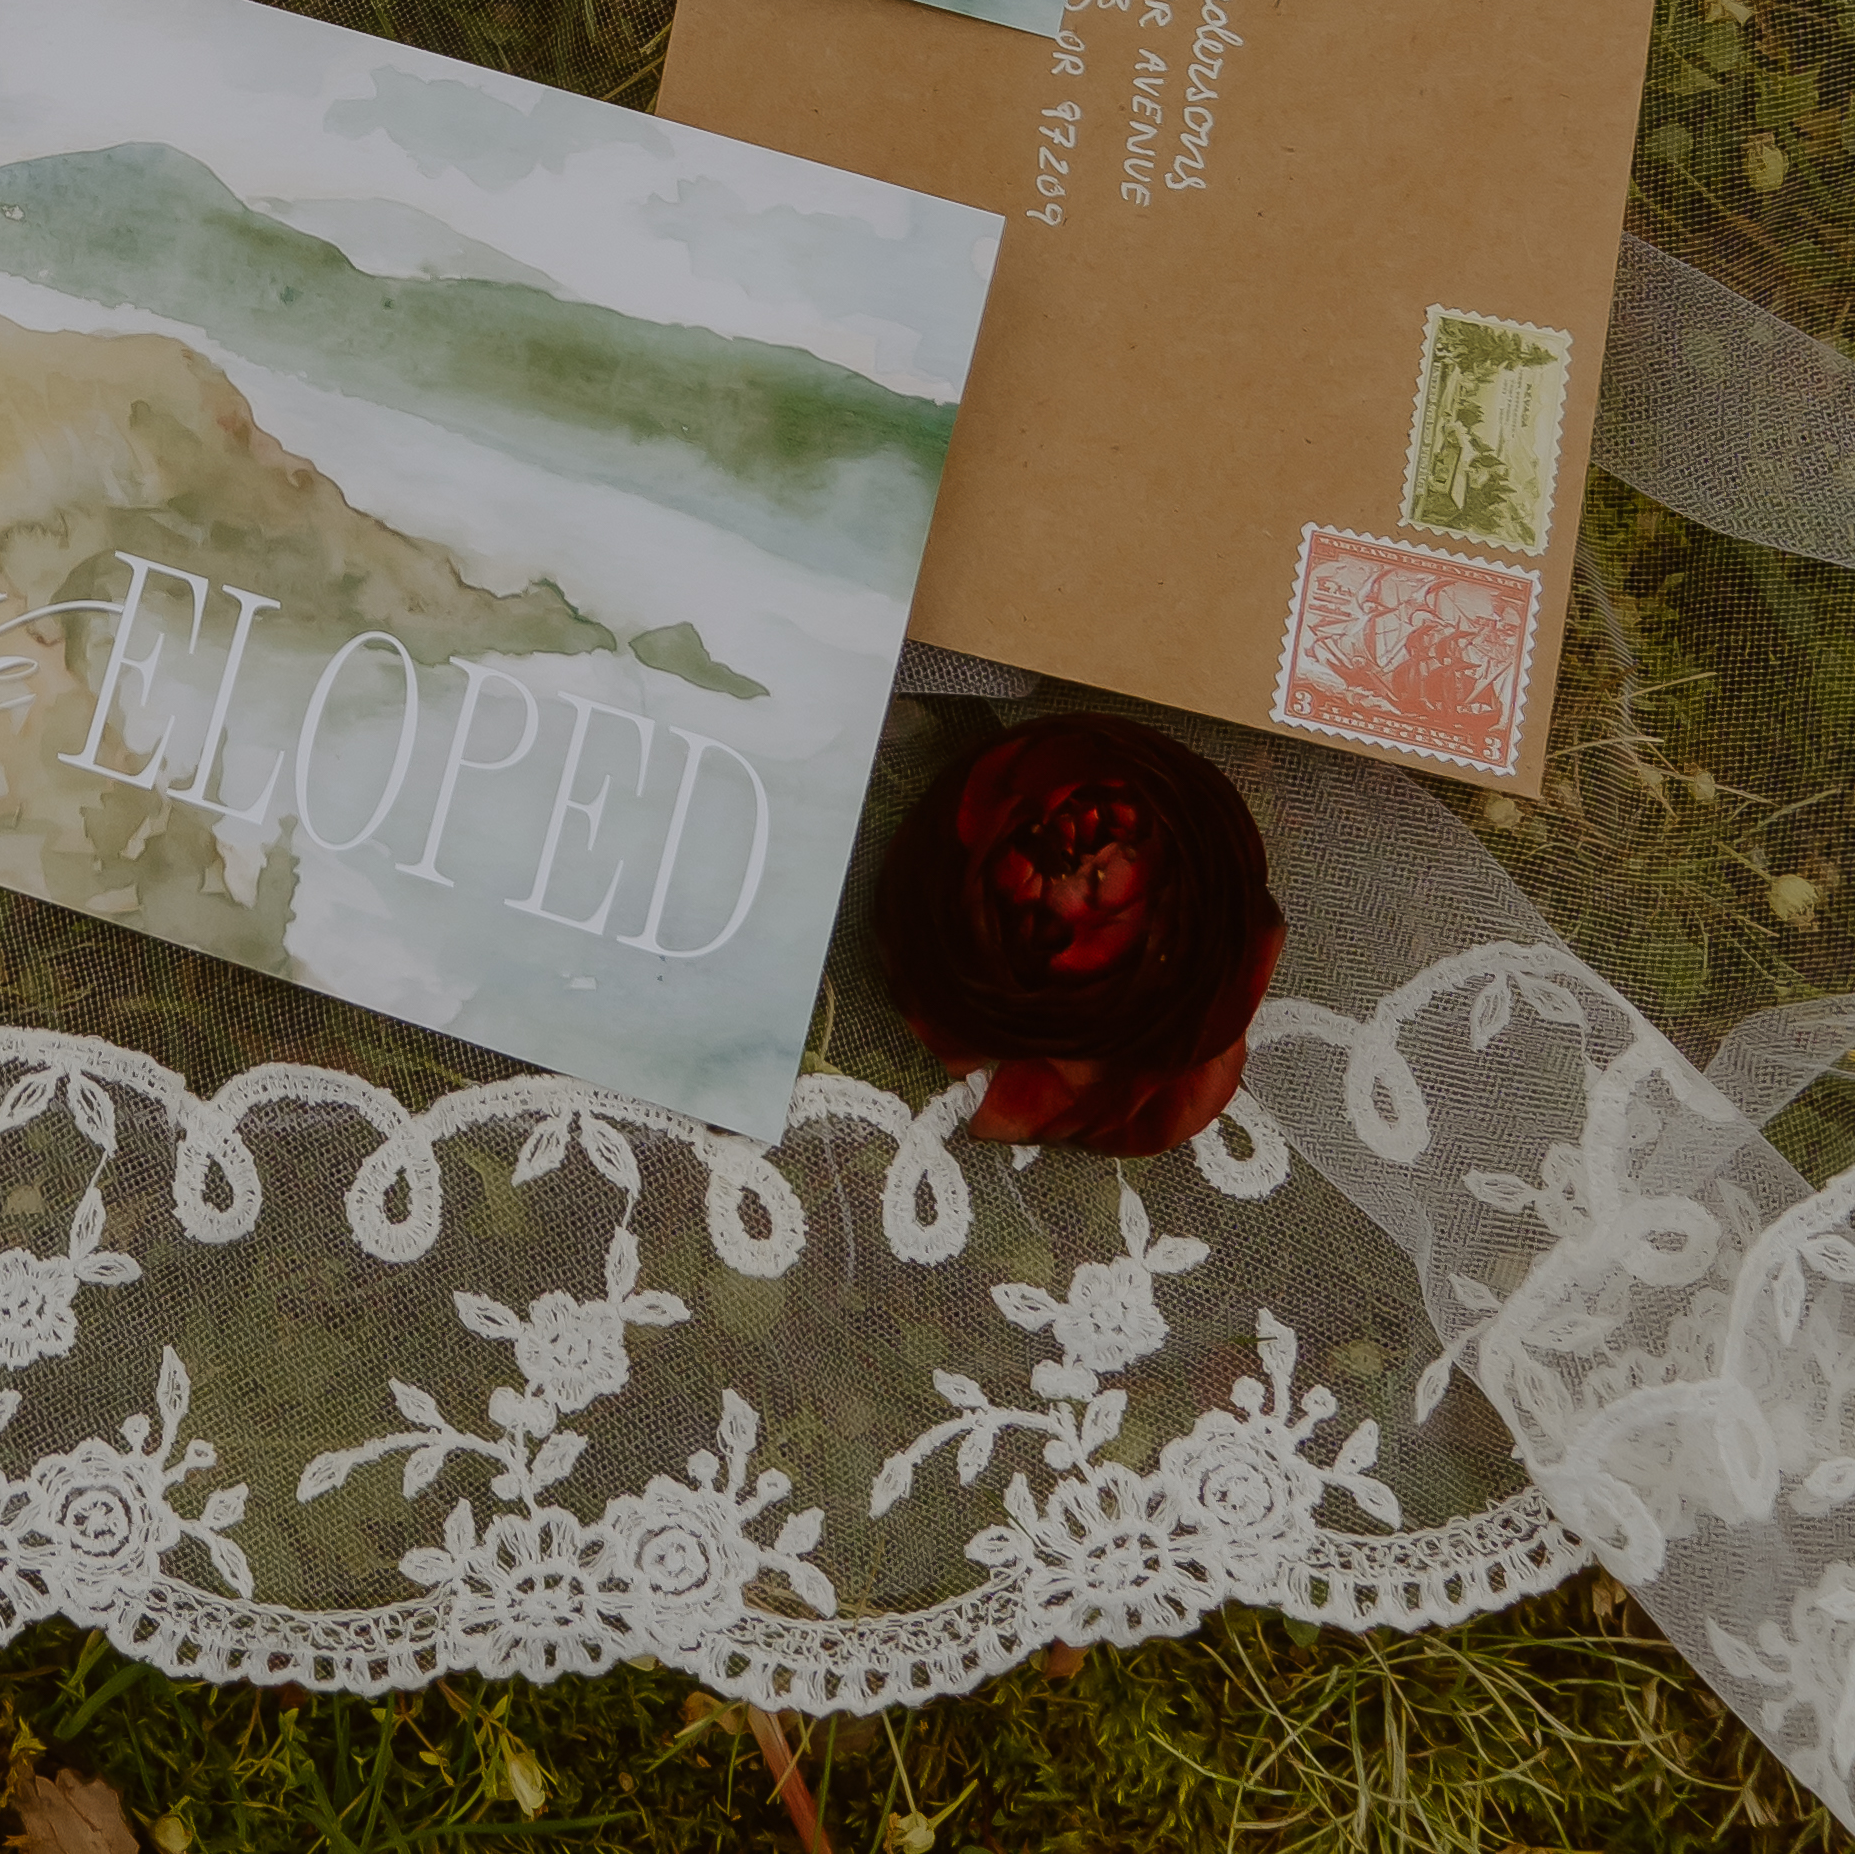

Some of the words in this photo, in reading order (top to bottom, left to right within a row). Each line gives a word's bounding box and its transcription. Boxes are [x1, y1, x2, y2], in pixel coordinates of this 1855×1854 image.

[1050, 26, 1087, 77] OR
[1025, 100, 1085, 227] 97209
[1120, 48, 1170, 207] AVENUE
[1290, 689, 1315, 715] 3
[57, 549, 771, 959] ELOPED
[1480, 734, 1504, 761] 3
